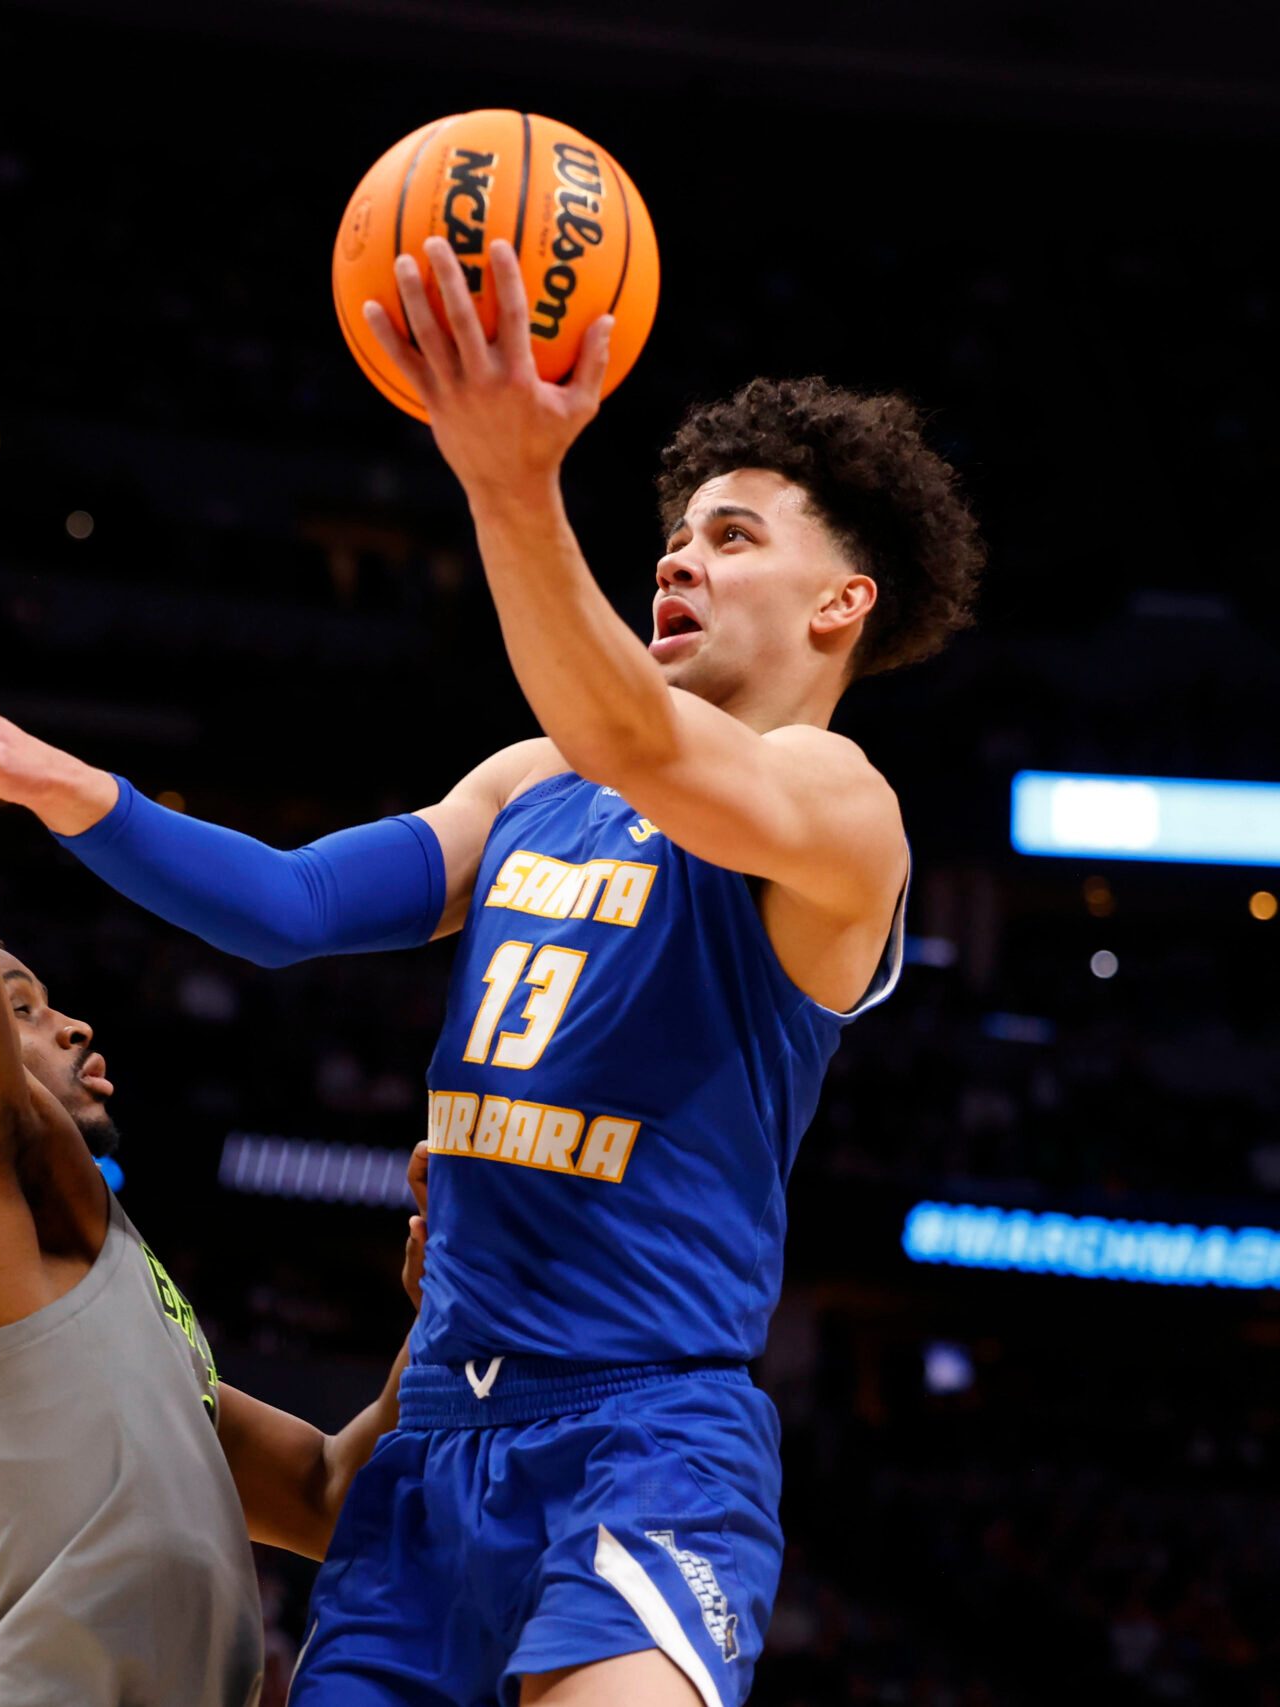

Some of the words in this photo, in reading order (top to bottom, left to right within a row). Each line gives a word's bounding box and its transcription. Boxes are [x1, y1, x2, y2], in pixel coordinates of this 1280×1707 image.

[529, 142, 603, 340] Wilson
[484, 850, 658, 928] SANTA
[463, 940, 588, 1070] 13
[428, 1089, 642, 1183] ARBARA
